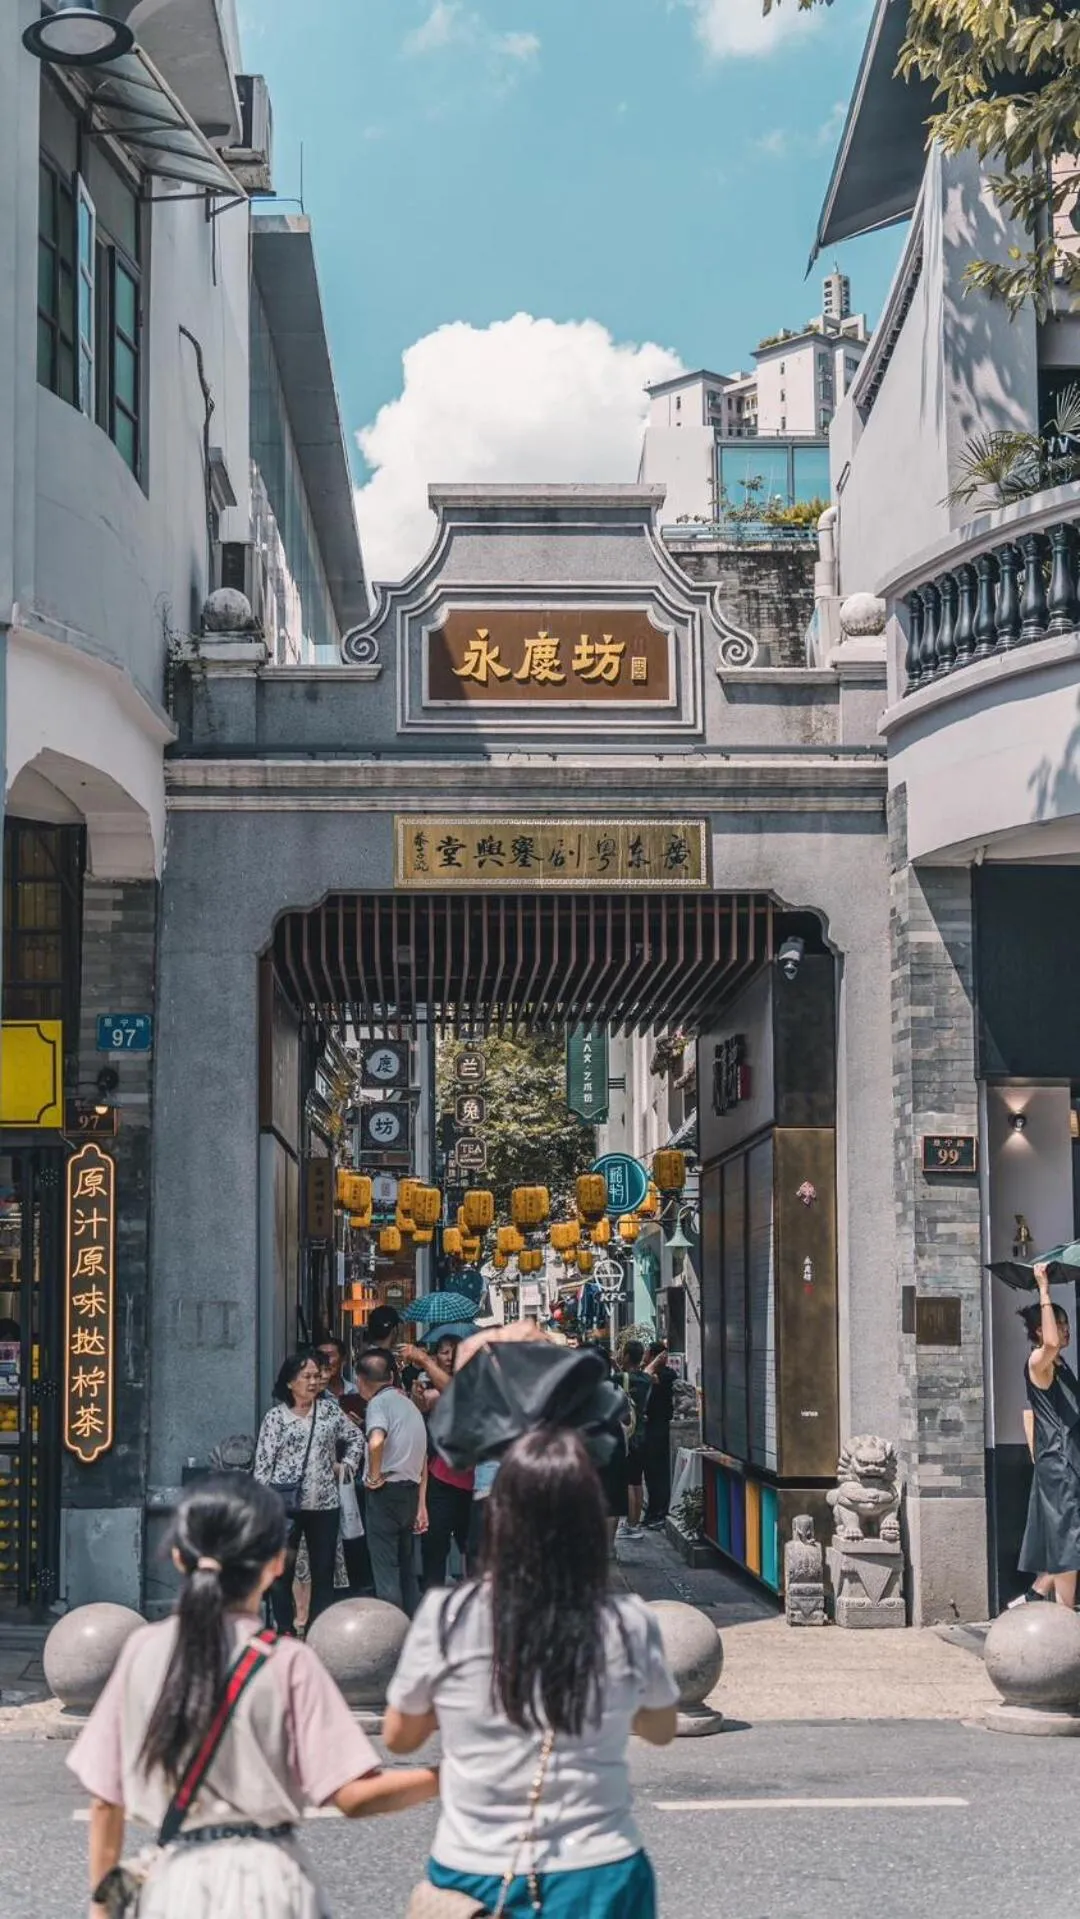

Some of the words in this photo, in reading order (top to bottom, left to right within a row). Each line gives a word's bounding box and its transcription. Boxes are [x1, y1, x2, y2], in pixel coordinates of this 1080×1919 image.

[452, 629, 626, 682] 永慶坊
[112, 1028, 136, 1047] 97
[79, 1115, 100, 1130] 97
[938, 1149, 959, 1165] 99
[72, 1167, 107, 1437] 原汁原味挞柠茶
[600, 1292, 627, 1302] KFC
